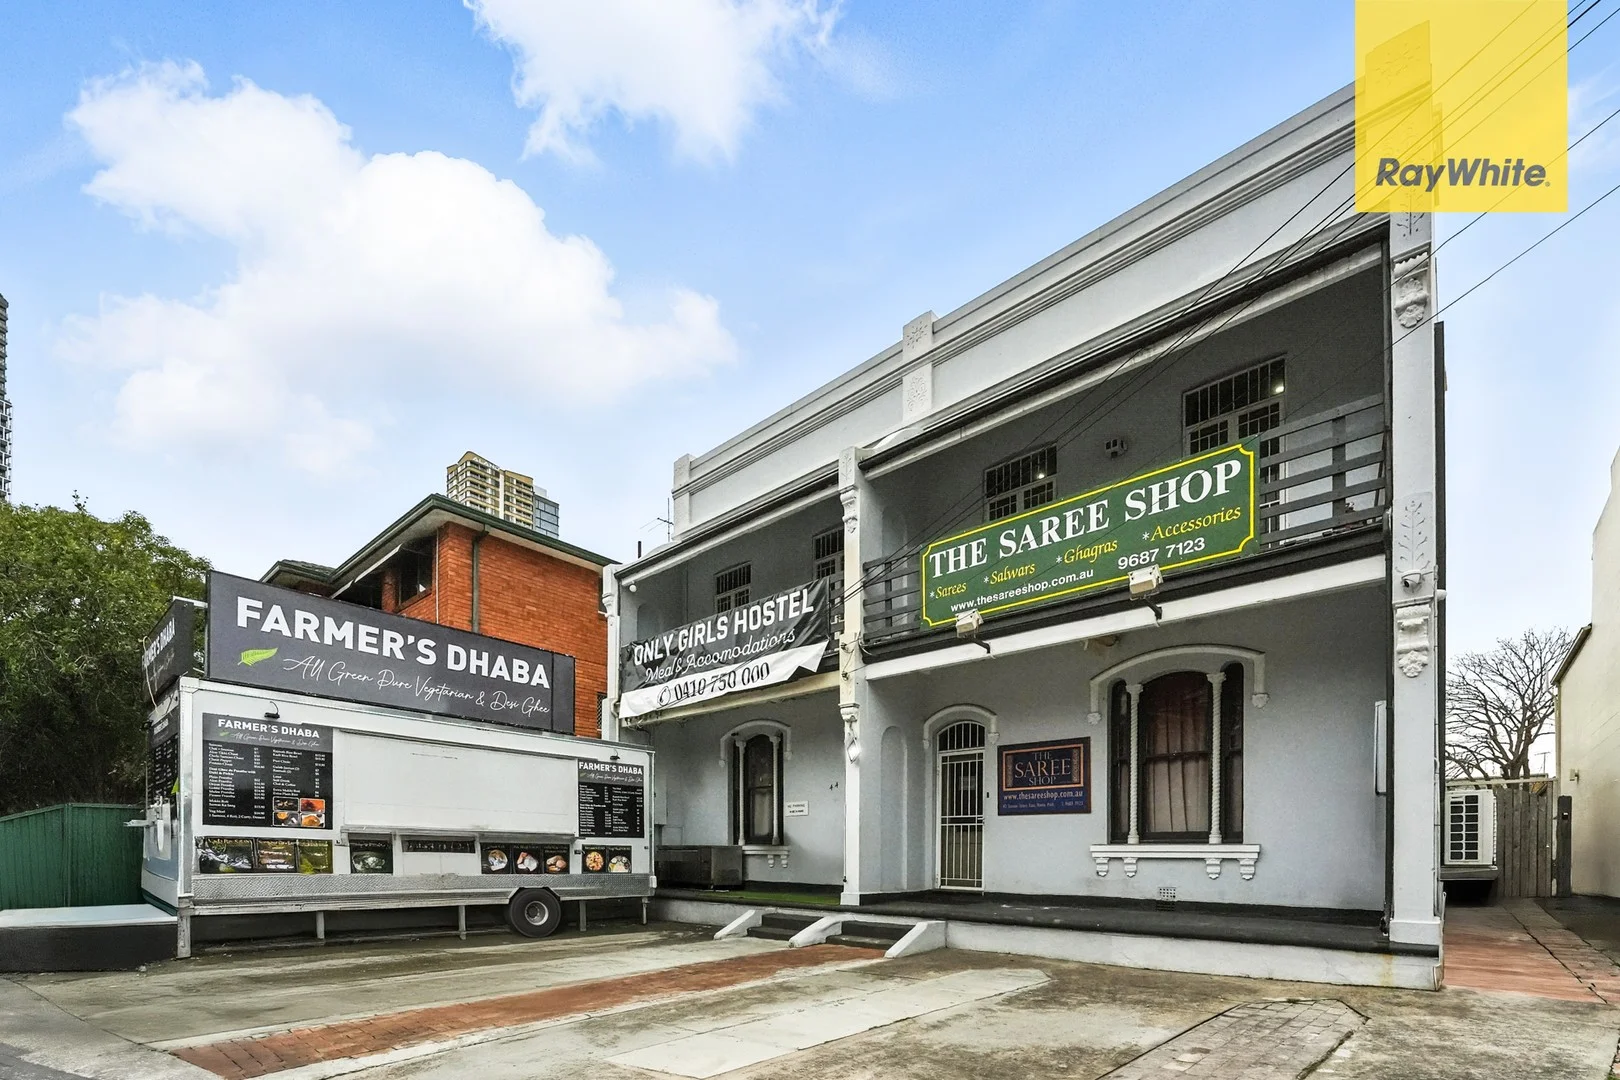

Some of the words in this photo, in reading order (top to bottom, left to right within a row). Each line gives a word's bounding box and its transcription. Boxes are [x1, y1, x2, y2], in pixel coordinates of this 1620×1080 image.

[929, 538, 988, 579] THE
[999, 499, 1110, 559] SAREE
[1124, 459, 1242, 522] SHOP
[935, 581, 967, 599] Sarees
[990, 563, 1036, 585] Salwars
[1063, 540, 1118, 564] Ghagras
[1150, 506, 1241, 542] Accessories
[1117, 548, 1160, 570] 9687
[1166, 537, 1205, 559] 7123
[950, 569, 1094, 612] www.thesareeshop.com.au
[237, 596, 437, 666] FARMER'S
[447, 643, 550, 689] DHABA
[634, 633, 675, 666] ONLY
[678, 615, 728, 652] GIRLS
[733, 588, 814, 635] HOSTEL
[681, 628, 796, 675] Accomodations
[283, 655, 325, 682] All
[328, 661, 373, 686] Green
[377, 669, 413, 690] Pure
[415, 676, 474, 702] Vegetarian
[475, 690, 485, 706] &
[490, 690, 519, 711] Desi
[521, 697, 550, 717] Ghee
[674, 678, 707, 701] 0410
[710, 670, 737, 692] 750
[741, 662, 770, 685] 000
[218, 718, 279, 734] FARMER'S
[281, 726, 320, 739] DHABA
[578, 761, 617, 772] FARMER'S
[618, 765, 643, 775] DHABA
[1014, 758, 1071, 779] SAREE
[1032, 752, 1052, 761] THE
[1029, 775, 1057, 786] SHOP
